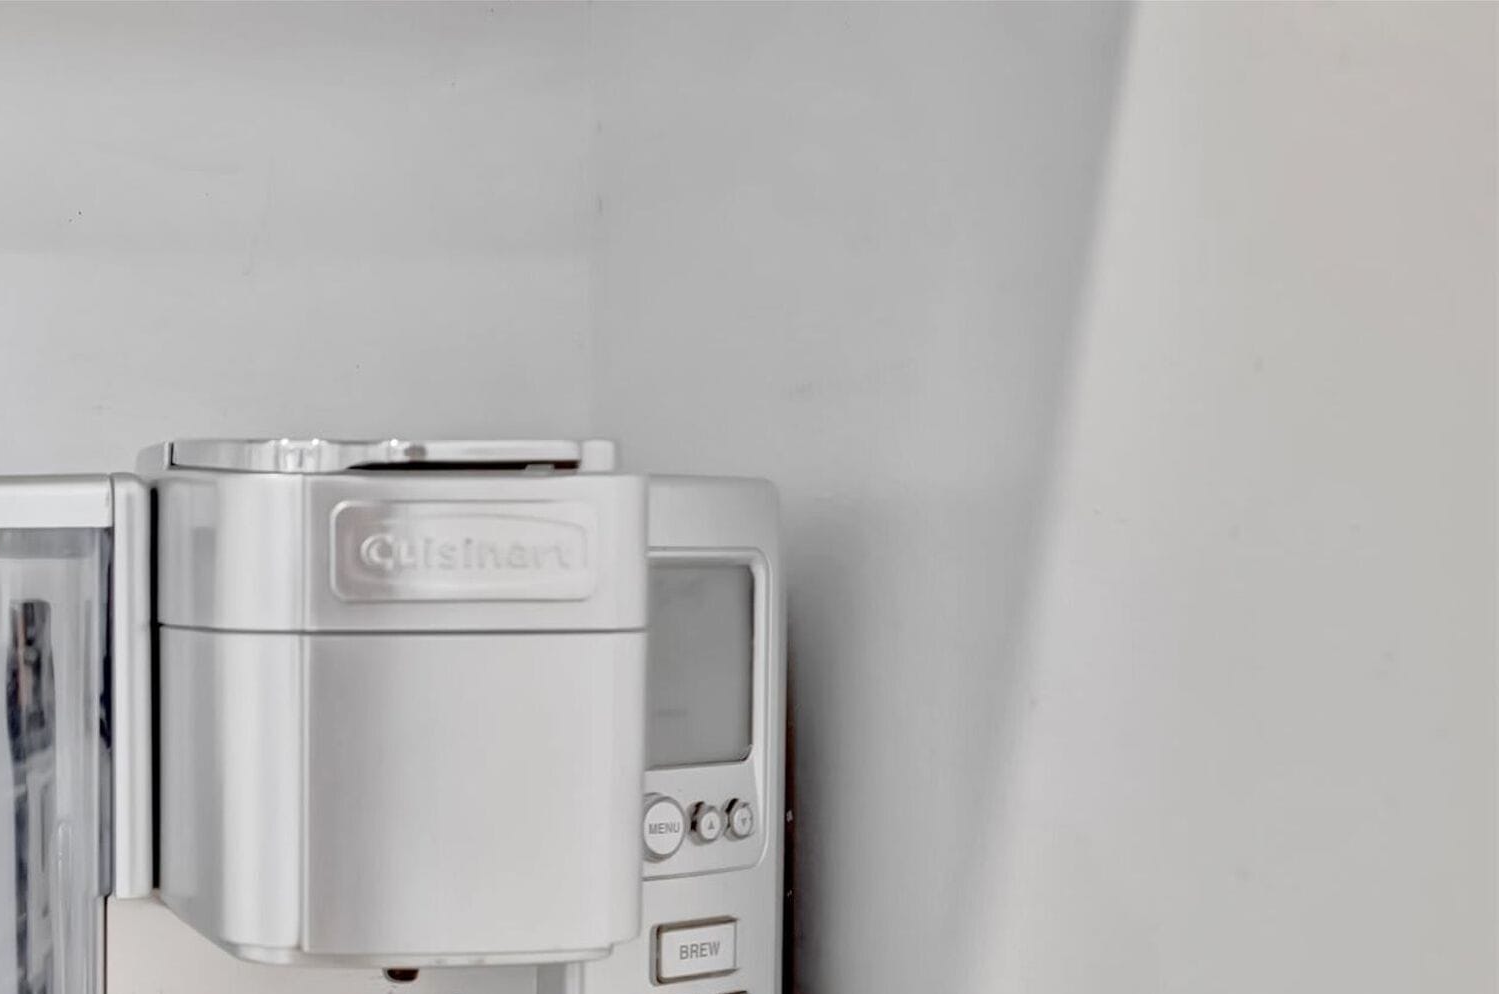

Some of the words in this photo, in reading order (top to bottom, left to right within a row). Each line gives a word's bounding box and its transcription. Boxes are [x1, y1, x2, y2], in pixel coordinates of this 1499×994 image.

[360, 532, 570, 572] Cuisinart
[648, 822, 680, 834] MENU
[679, 941, 721, 960] BREW
